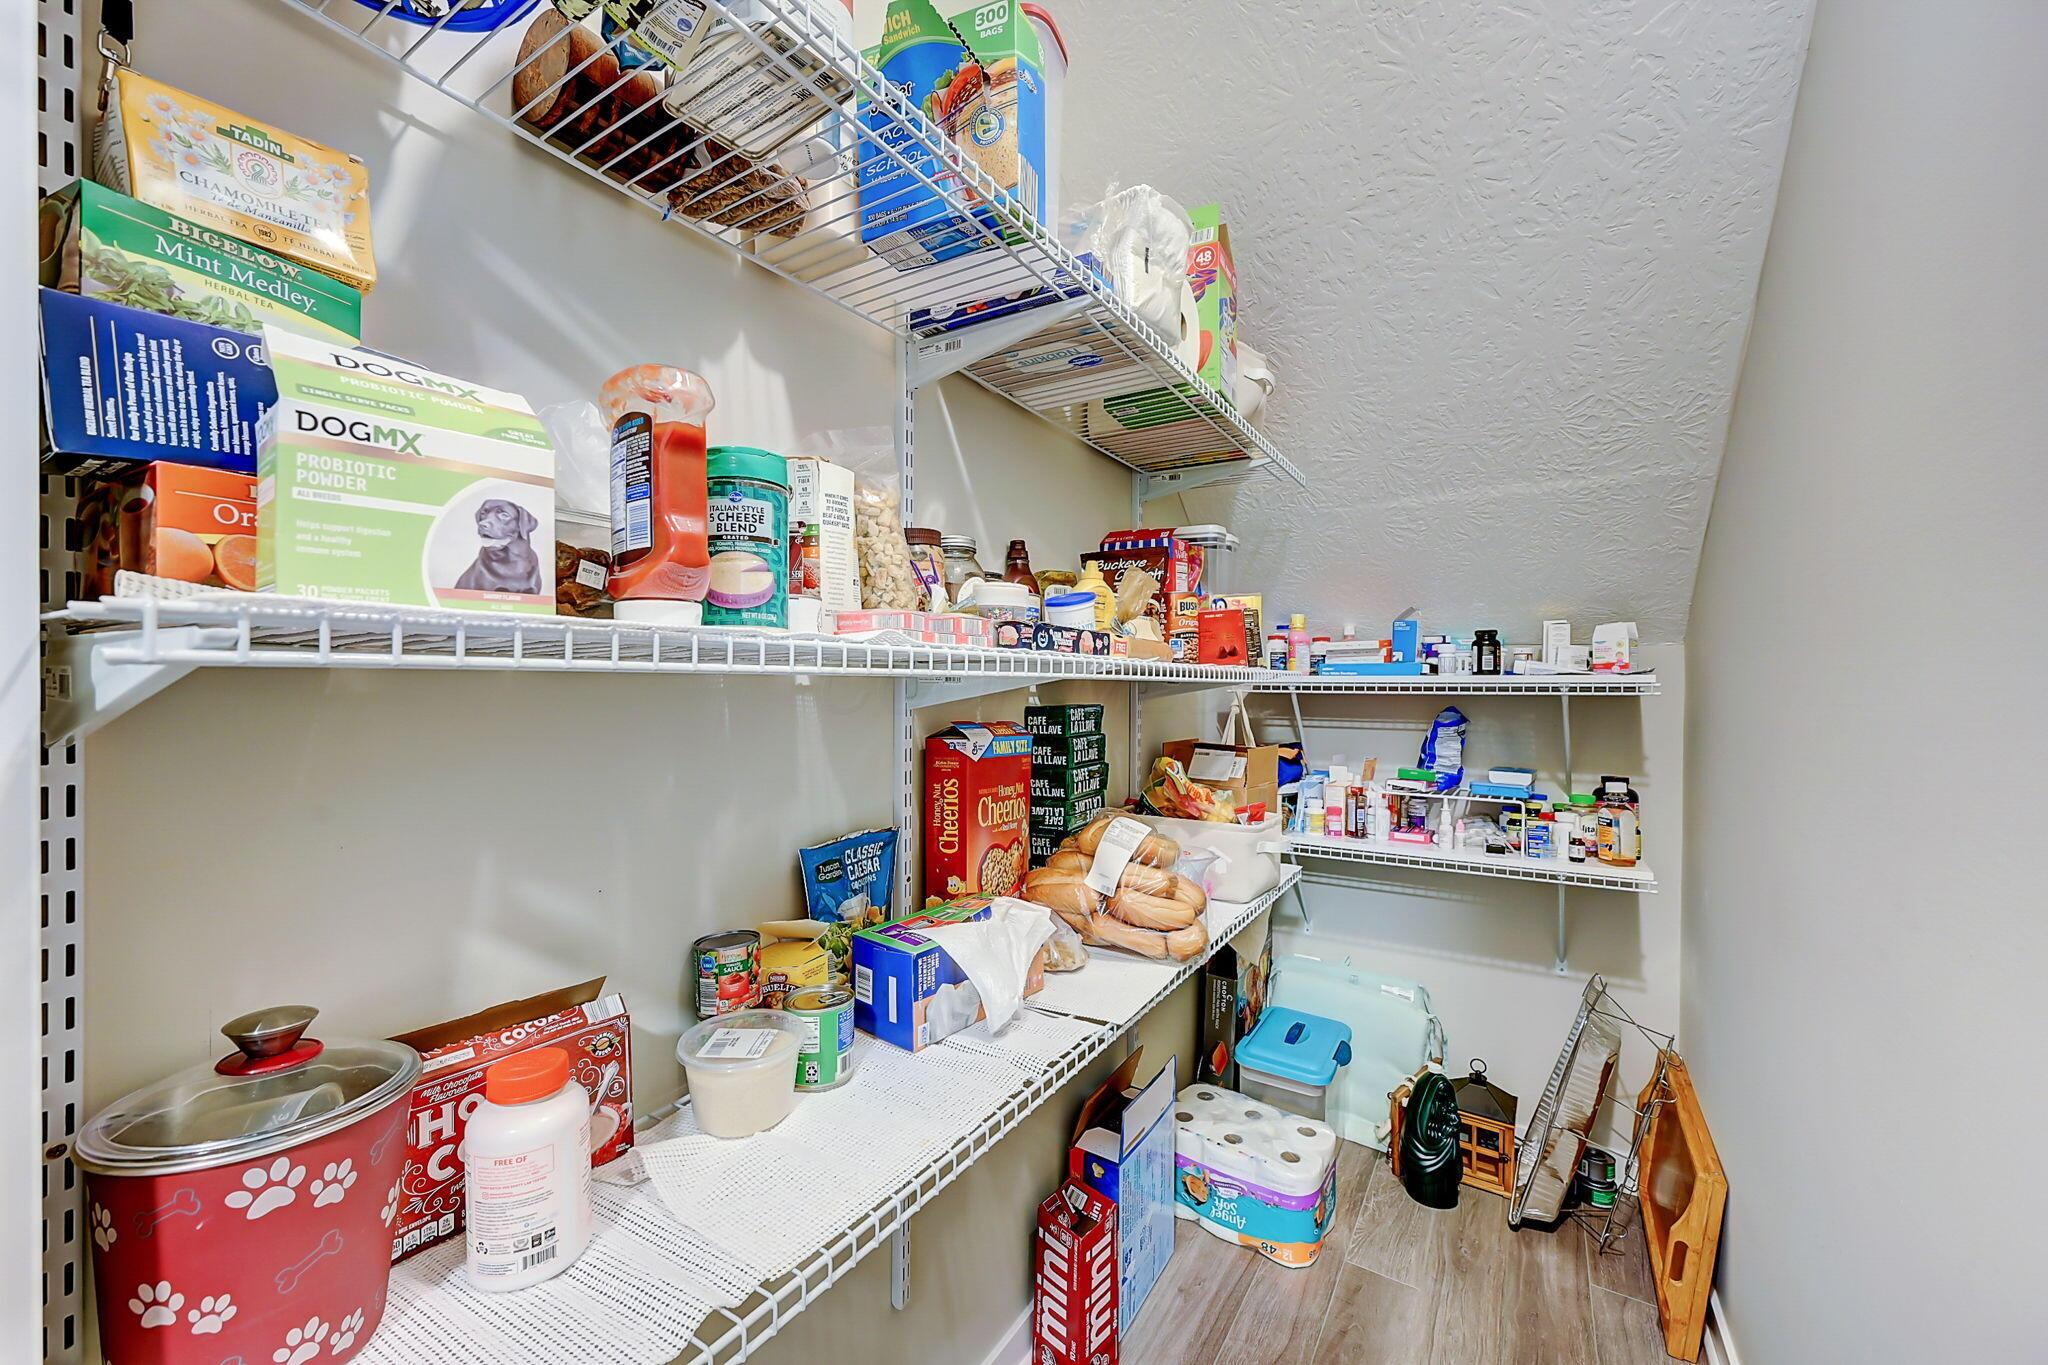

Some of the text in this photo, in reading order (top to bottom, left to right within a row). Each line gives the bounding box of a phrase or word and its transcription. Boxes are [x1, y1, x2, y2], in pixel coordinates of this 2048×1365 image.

[976, 4, 1008, 27] 300
[883, 26, 921, 44] Sandwich
[980, 26, 1003, 38] BAGS
[232, 126, 283, 156] TADIN
[180, 170, 299, 222] CHAMOMILE
[229, 217, 248, 231] TEA
[242, 205, 312, 234] Manzanilla
[258, 228, 272, 239] 1982
[156, 234, 221, 276] Mint
[169, 216, 301, 280] BIGELOW
[204, 279, 274, 310] HERBAL TEA
[79, 356, 91, 375] BLEND
[329, 352, 485, 404] DOGMX
[126, 388, 136, 406] Proud
[301, 386, 410, 414] SINGLE SERVE PACKS
[339, 376, 484, 414] PROBIOTIC POWDER
[128, 412, 140, 430] Family
[296, 410, 424, 457] DOGMX
[296, 453, 397, 480] PROBIOTIC
[296, 468, 368, 492] POWDER
[709, 505, 765, 514] ITALIAN STYLE
[709, 512, 765, 524] 5 CHEESE
[716, 523, 757, 534] BLEND
[296, 583, 319, 599] 30
[1028, 716, 1046, 726] CAFE
[1070, 708, 1084, 721] CAFE
[1028, 725, 1062, 734] LA LLAVE
[1070, 719, 1095, 733] LA LLAVE
[992, 741, 1015, 755] FAMILY
[1032, 746, 1052, 756] CAFE
[1073, 738, 1088, 750] CAFE
[1032, 756, 1067, 765] LA LLAVE
[1073, 748, 1098, 763] LA LLAVE
[1030, 779, 1049, 788] CAFE
[1073, 768, 1089, 782] CAFE
[998, 782, 1024, 797] Honey Nut
[1031, 788, 1065, 797] LA LLAVE
[1073, 778, 1100, 795] LA LLAVE
[933, 783, 942, 827] Honey Nut
[977, 796, 1026, 828] Cheerios
[1031, 807, 1064, 816] LA LLAVE
[939, 778, 959, 854] Cheerios
[1044, 816, 1064, 825] CAFE
[1032, 837, 1050, 846] CAFE
[844, 842, 884, 864] CLASSIC
[1032, 846, 1042, 855] LA
[818, 869, 842, 882] Garden
[819, 862, 840, 874] Tuscan
[847, 857, 880, 882] CAESAR
[762, 983, 797, 994] BUELIT
[500, 1013, 561, 1045] COCOA
[421, 1071, 484, 1099] Milk Chocolate
[429, 1086, 468, 1103] Flavored
[416, 1093, 487, 1149] HO
[516, 1156, 528, 1164] OF
[1214, 1197, 1237, 1215] Soft
[1208, 1206, 1246, 1230] Angel
[1037, 1226, 1068, 1355] mini
[1085, 1231, 1111, 1353] mini
